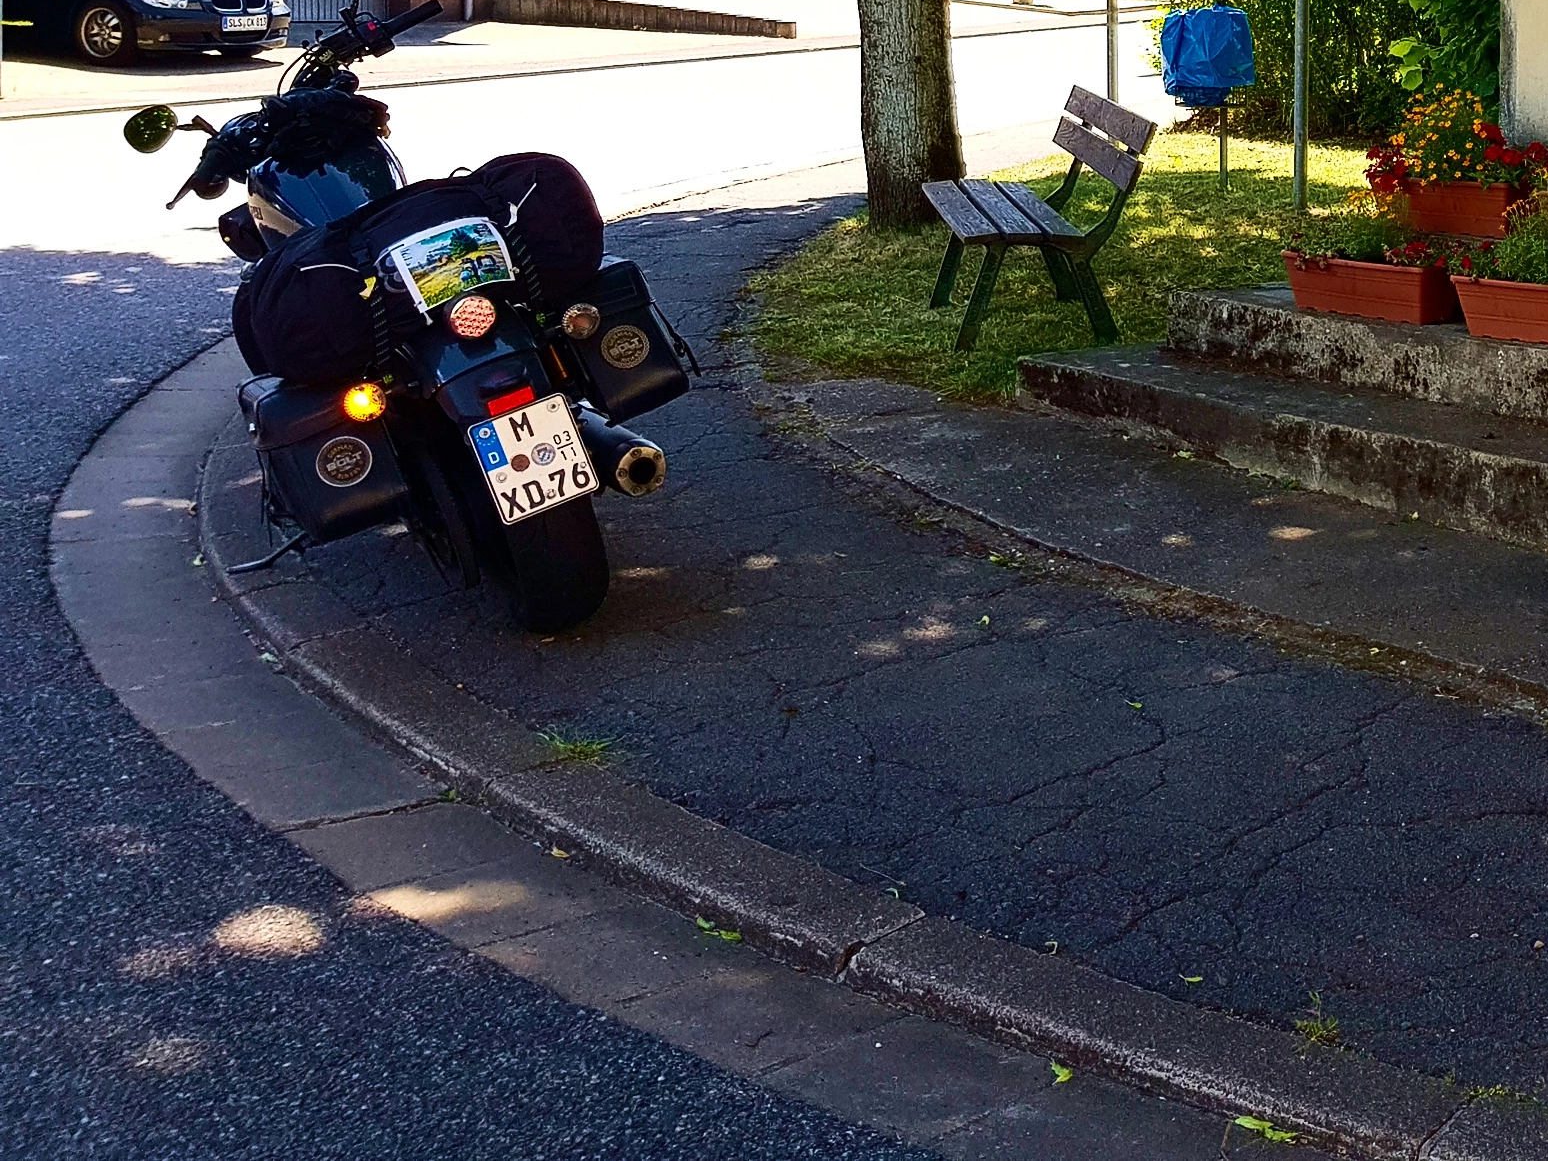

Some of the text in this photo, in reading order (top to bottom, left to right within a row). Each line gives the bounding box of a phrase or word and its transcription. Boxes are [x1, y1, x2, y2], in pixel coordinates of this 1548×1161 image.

[508, 411, 534, 443] M
[552, 430, 572, 446] 03
[487, 451, 500, 465] D
